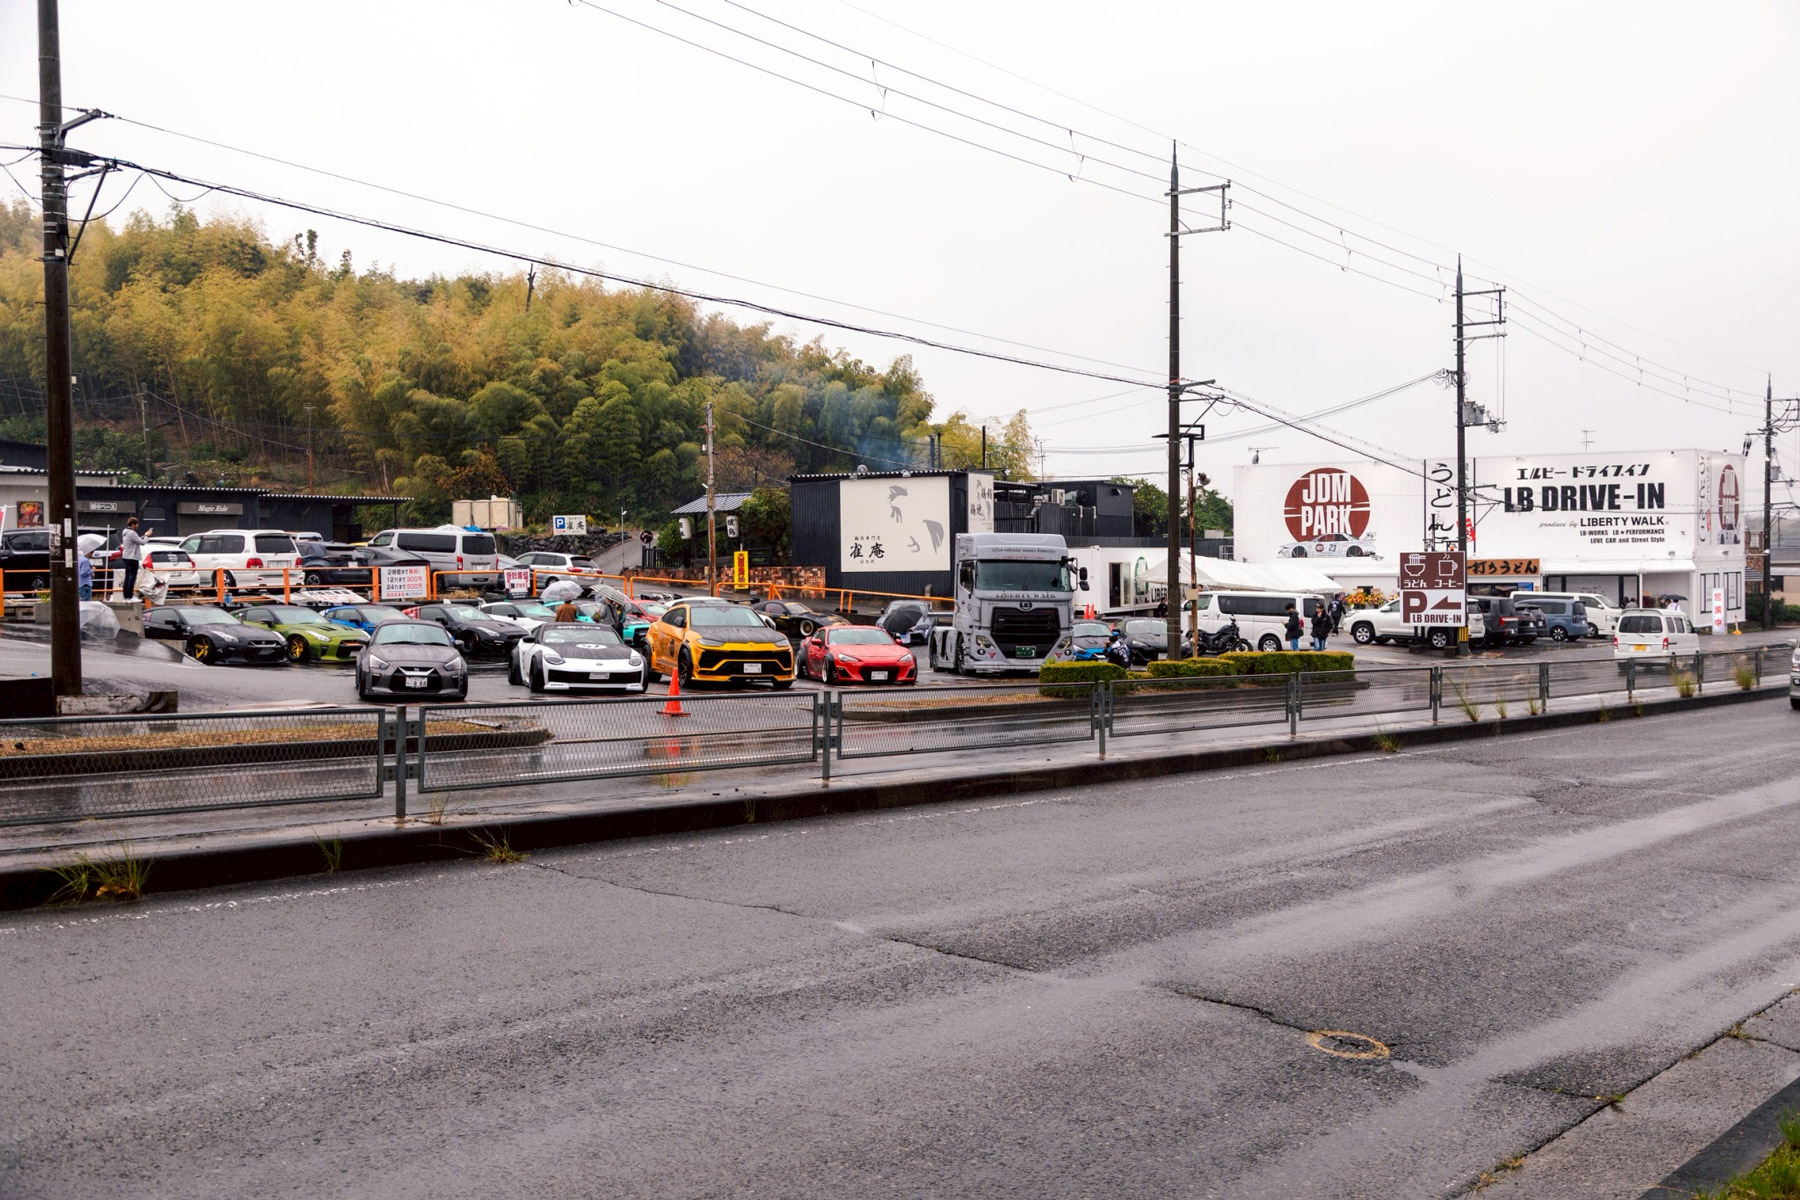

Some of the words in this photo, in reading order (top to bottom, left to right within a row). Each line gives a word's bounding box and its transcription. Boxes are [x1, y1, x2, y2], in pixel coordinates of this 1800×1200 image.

[1572, 464, 1650, 479] ドライブイン
[1302, 473, 1352, 503] JDM
[1504, 486, 1534, 513] LB
[1541, 482, 1665, 512] DRIVE-IN
[198, 504, 215, 512] Magic
[215, 504, 228, 512] Ride
[1301, 504, 1353, 536] PARK
[1538, 520, 1566, 528] produce
[1569, 519, 1577, 528] by
[1580, 517, 1628, 527] LIBERTY
[1631, 516, 1664, 526] WALK
[1467, 560, 1538, 575] 打ちうどん
[1404, 579, 1427, 588] うどん
[1434, 579, 1463, 588] コーヒー
[1402, 591, 1427, 623] P
[1412, 614, 1422, 623] LB
[1424, 614, 1462, 623] DRIVE-IN
